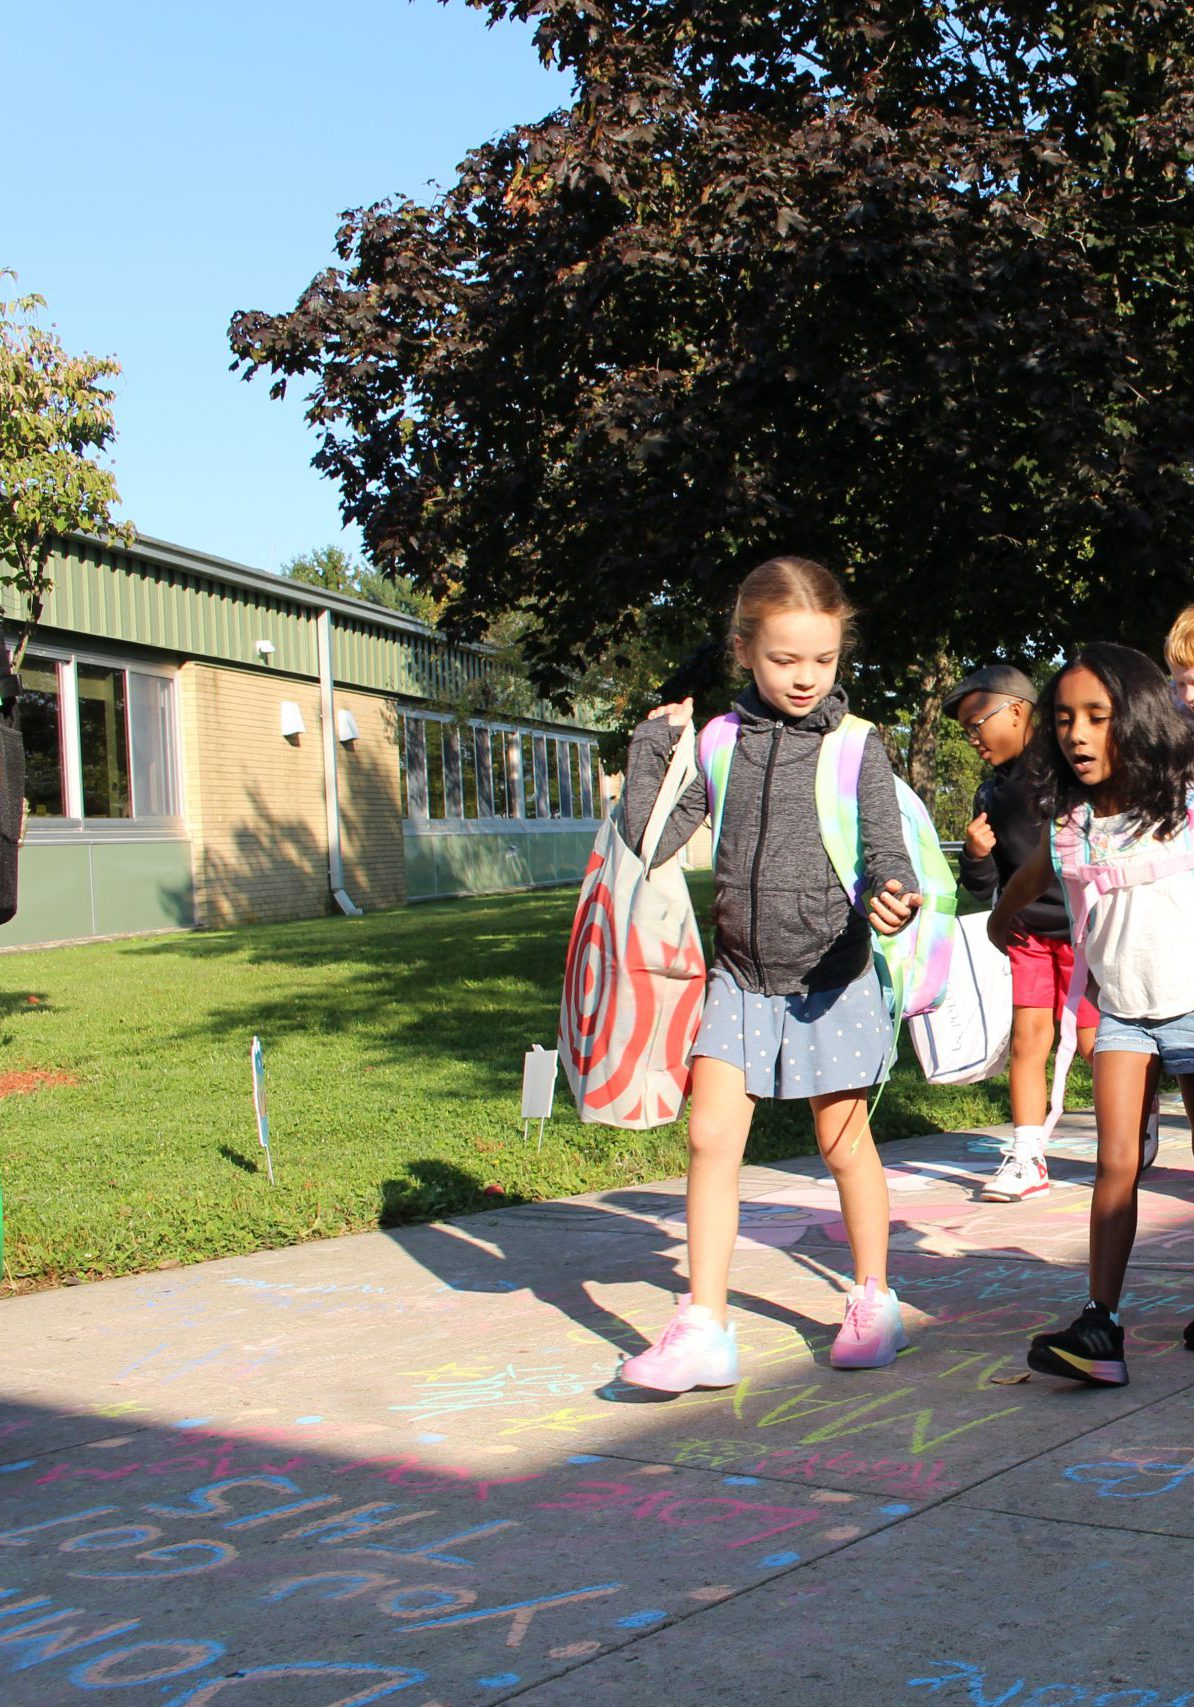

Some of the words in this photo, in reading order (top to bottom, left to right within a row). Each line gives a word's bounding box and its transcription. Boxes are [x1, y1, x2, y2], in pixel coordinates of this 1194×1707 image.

[654, 1375, 1024, 1455] MAX
[35, 1456, 304, 1485] MOM
[333, 1454, 540, 1502] YOU
[0, 1505, 242, 1580] GOT
[142, 1474, 520, 1570] THIS
[533, 1480, 828, 1550] LOVE
[256, 1570, 626, 1647] YOU
